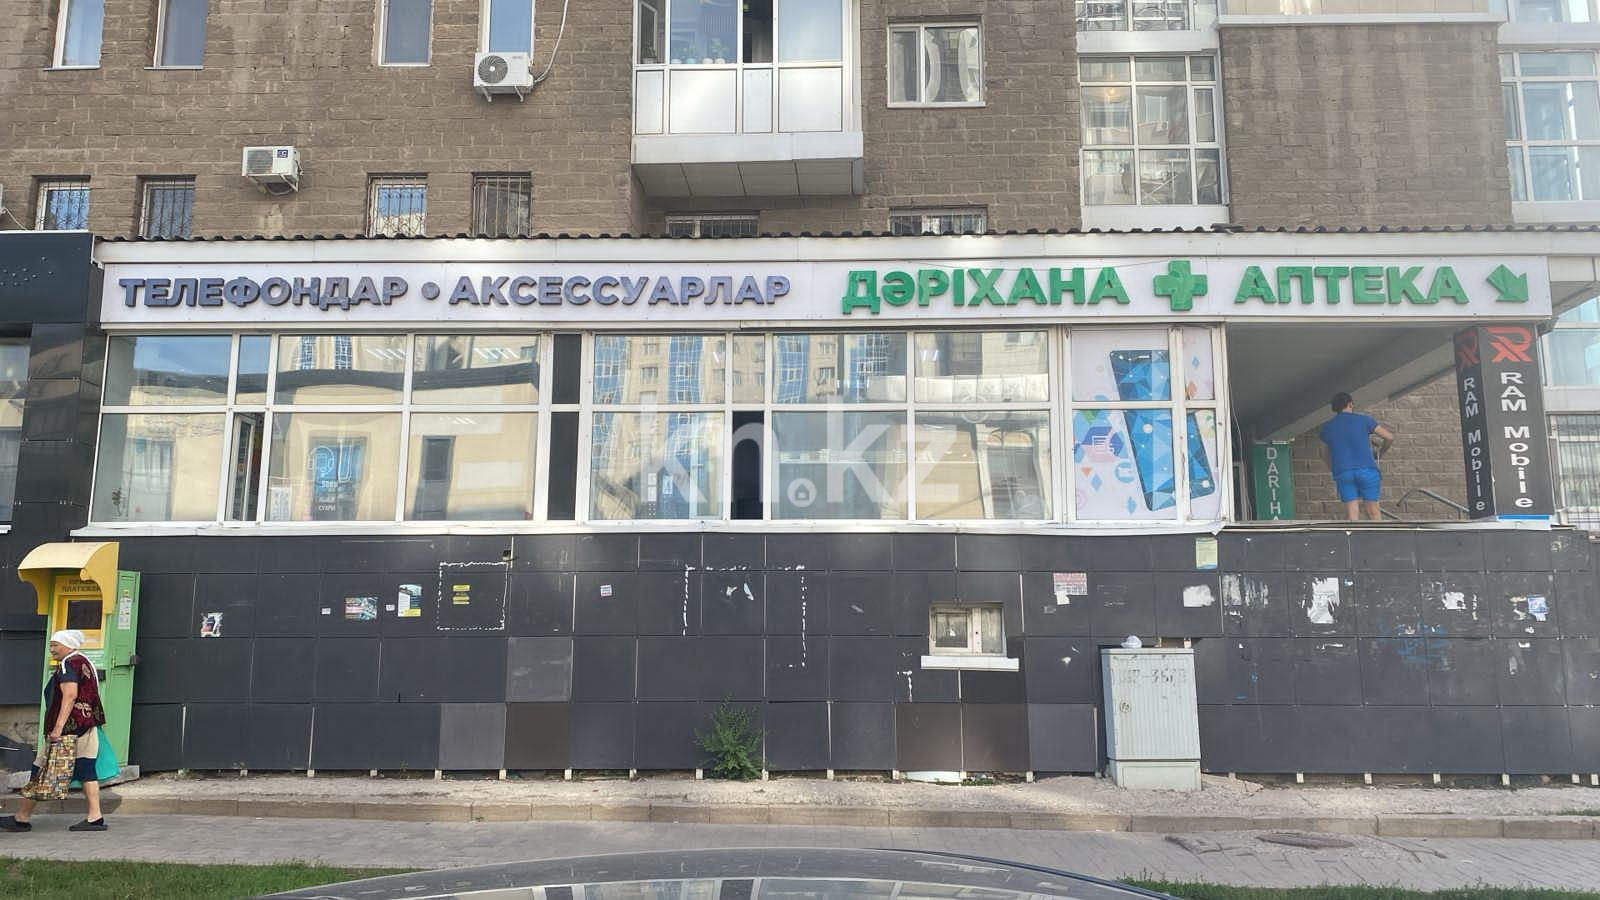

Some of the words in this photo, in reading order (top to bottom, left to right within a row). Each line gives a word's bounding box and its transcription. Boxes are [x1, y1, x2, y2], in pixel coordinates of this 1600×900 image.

[119, 276, 408, 311] ТЕЛЕФОНДАР
[448, 275, 791, 306] АКСЕССУАРЛАР
[842, 266, 1131, 315] ДӘРІХАНА
[1234, 265, 1470, 305] АПТЕКА
[1463, 377, 1479, 418] RAM
[1500, 371, 1527, 412] RAM
[1266, 447, 1281, 520] DARIH
[1467, 428, 1486, 511] Mobile
[1504, 425, 1535, 508] Mobile
